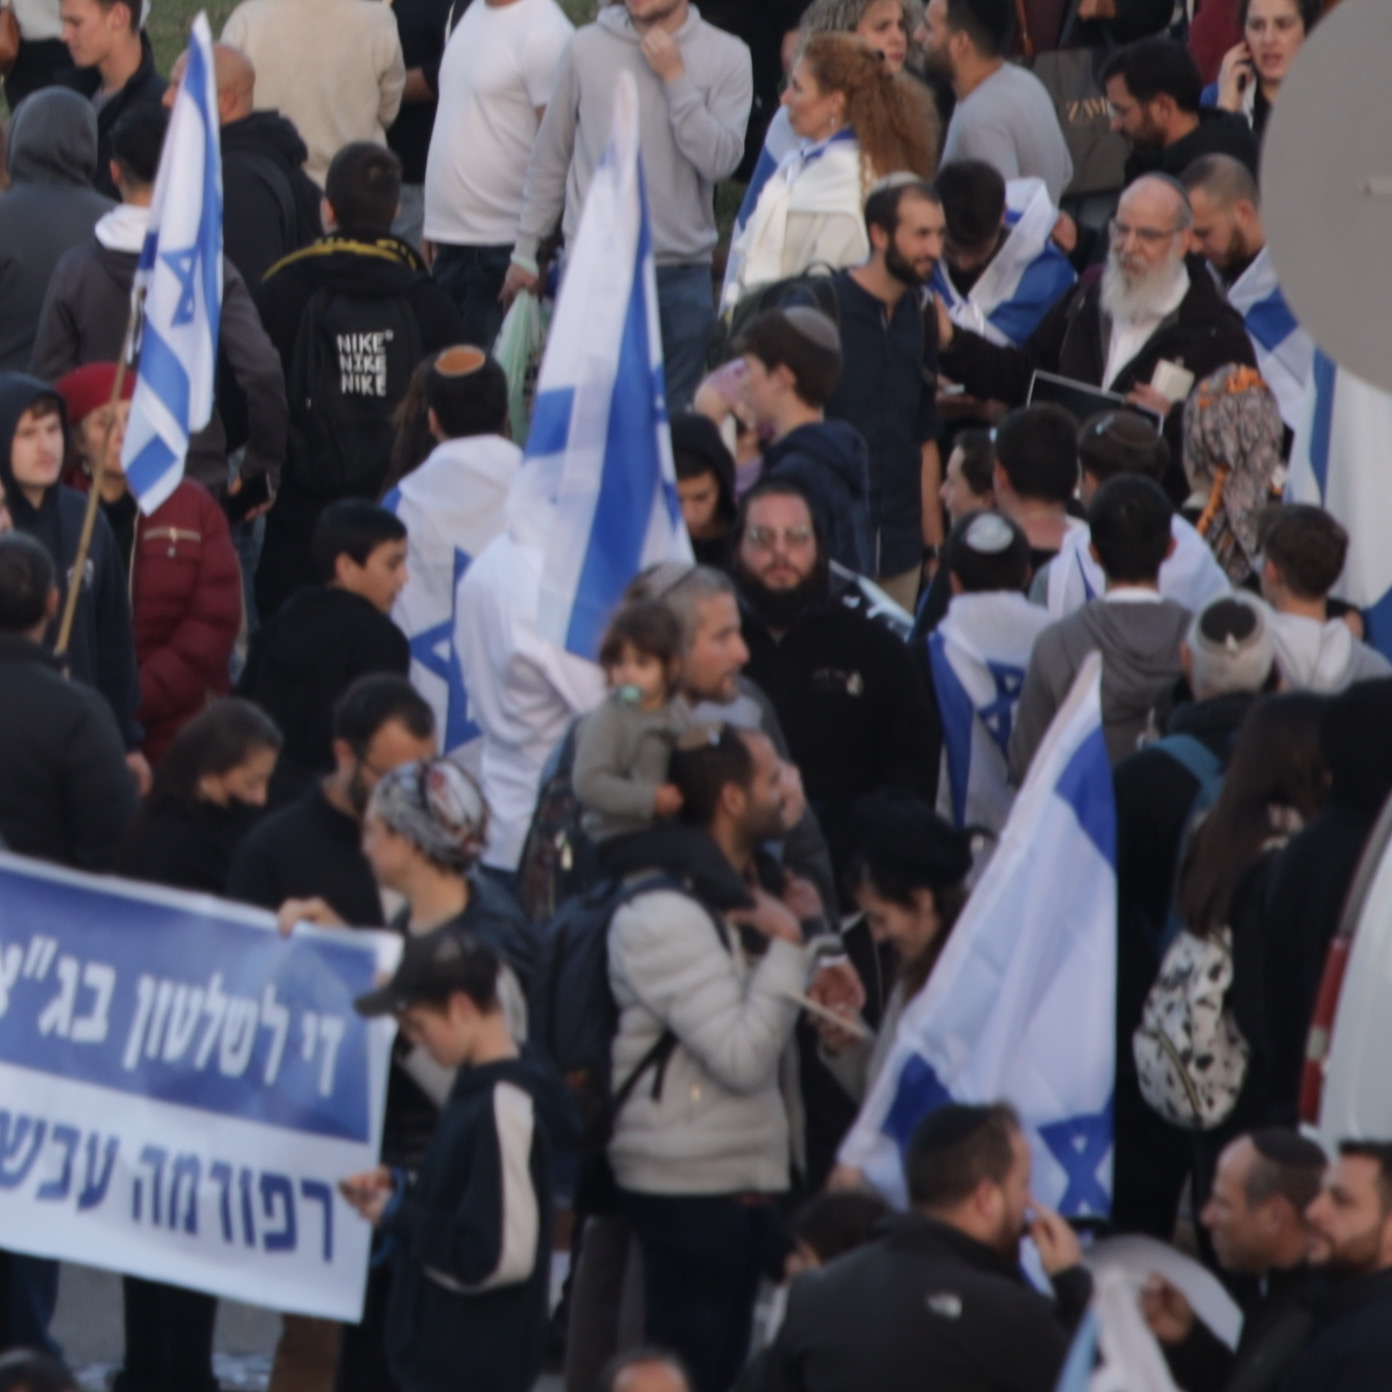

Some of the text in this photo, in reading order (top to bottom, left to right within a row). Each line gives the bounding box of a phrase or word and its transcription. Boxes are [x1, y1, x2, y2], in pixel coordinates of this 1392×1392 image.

[337, 331, 386, 354] NIKE
[339, 354, 386, 376] NIKE
[342, 374, 386, 397] NIKE
[122, 972, 289, 1085] לשלטון
[301, 1010, 344, 1098] די
[131, 1144, 334, 1264] רפורמה
